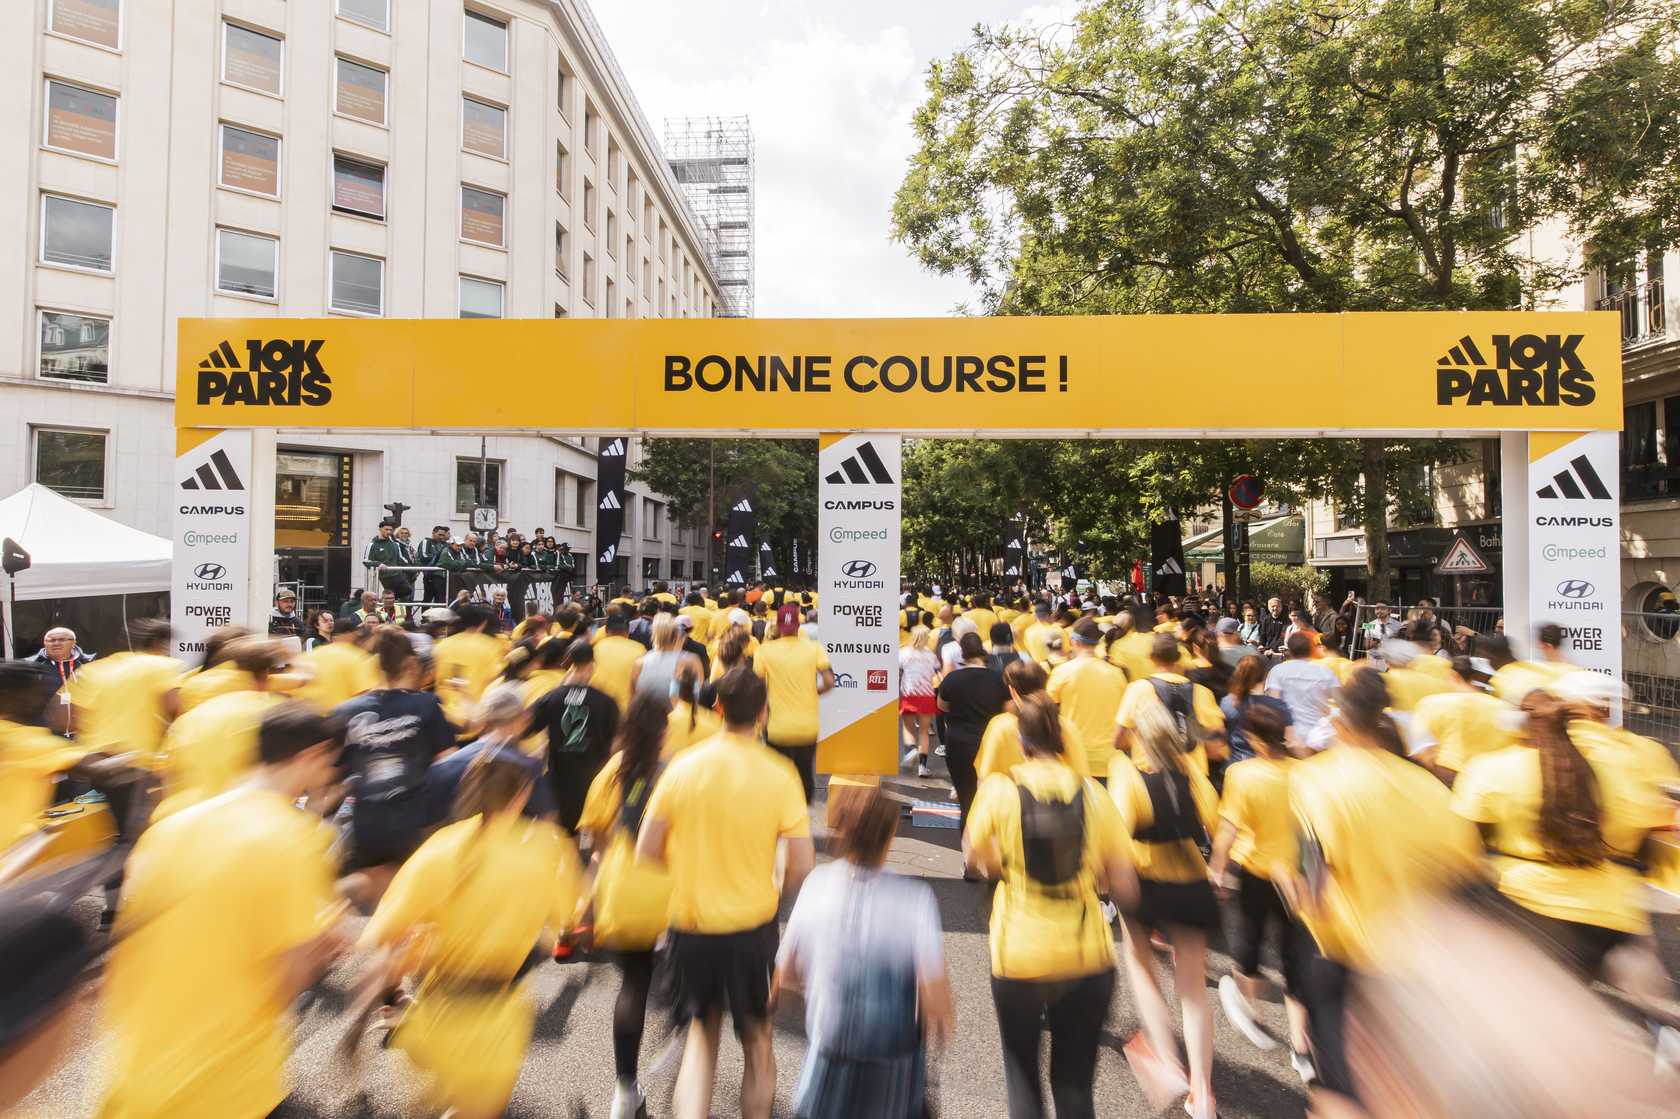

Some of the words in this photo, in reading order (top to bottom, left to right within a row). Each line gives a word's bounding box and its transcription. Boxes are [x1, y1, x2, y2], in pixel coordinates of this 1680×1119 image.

[246, 339, 326, 371] 10K
[1492, 334, 1586, 369] 10K
[664, 355, 832, 393] BONNE
[843, 355, 1047, 393] COURSE
[197, 371, 332, 407] PARIS
[1436, 369, 1596, 407] PARIS
[179, 505, 245, 516] CAMPUS
[824, 500, 895, 511] CAMPUS
[1536, 516, 1614, 528] CAMPUS
[183, 530, 238, 547] Compeed
[829, 526, 888, 544] Compeed
[1542, 543, 1606, 562] Compeed
[834, 581, 884, 589] HYUNDAI
[186, 606, 231, 617] POWER
[833, 605, 882, 616] POWER
[1548, 601, 1604, 610] HYUNDAI
[855, 616, 882, 627] ADE
[827, 643, 890, 654] SAMSUNG
[1572, 639, 1602, 651] ADE
